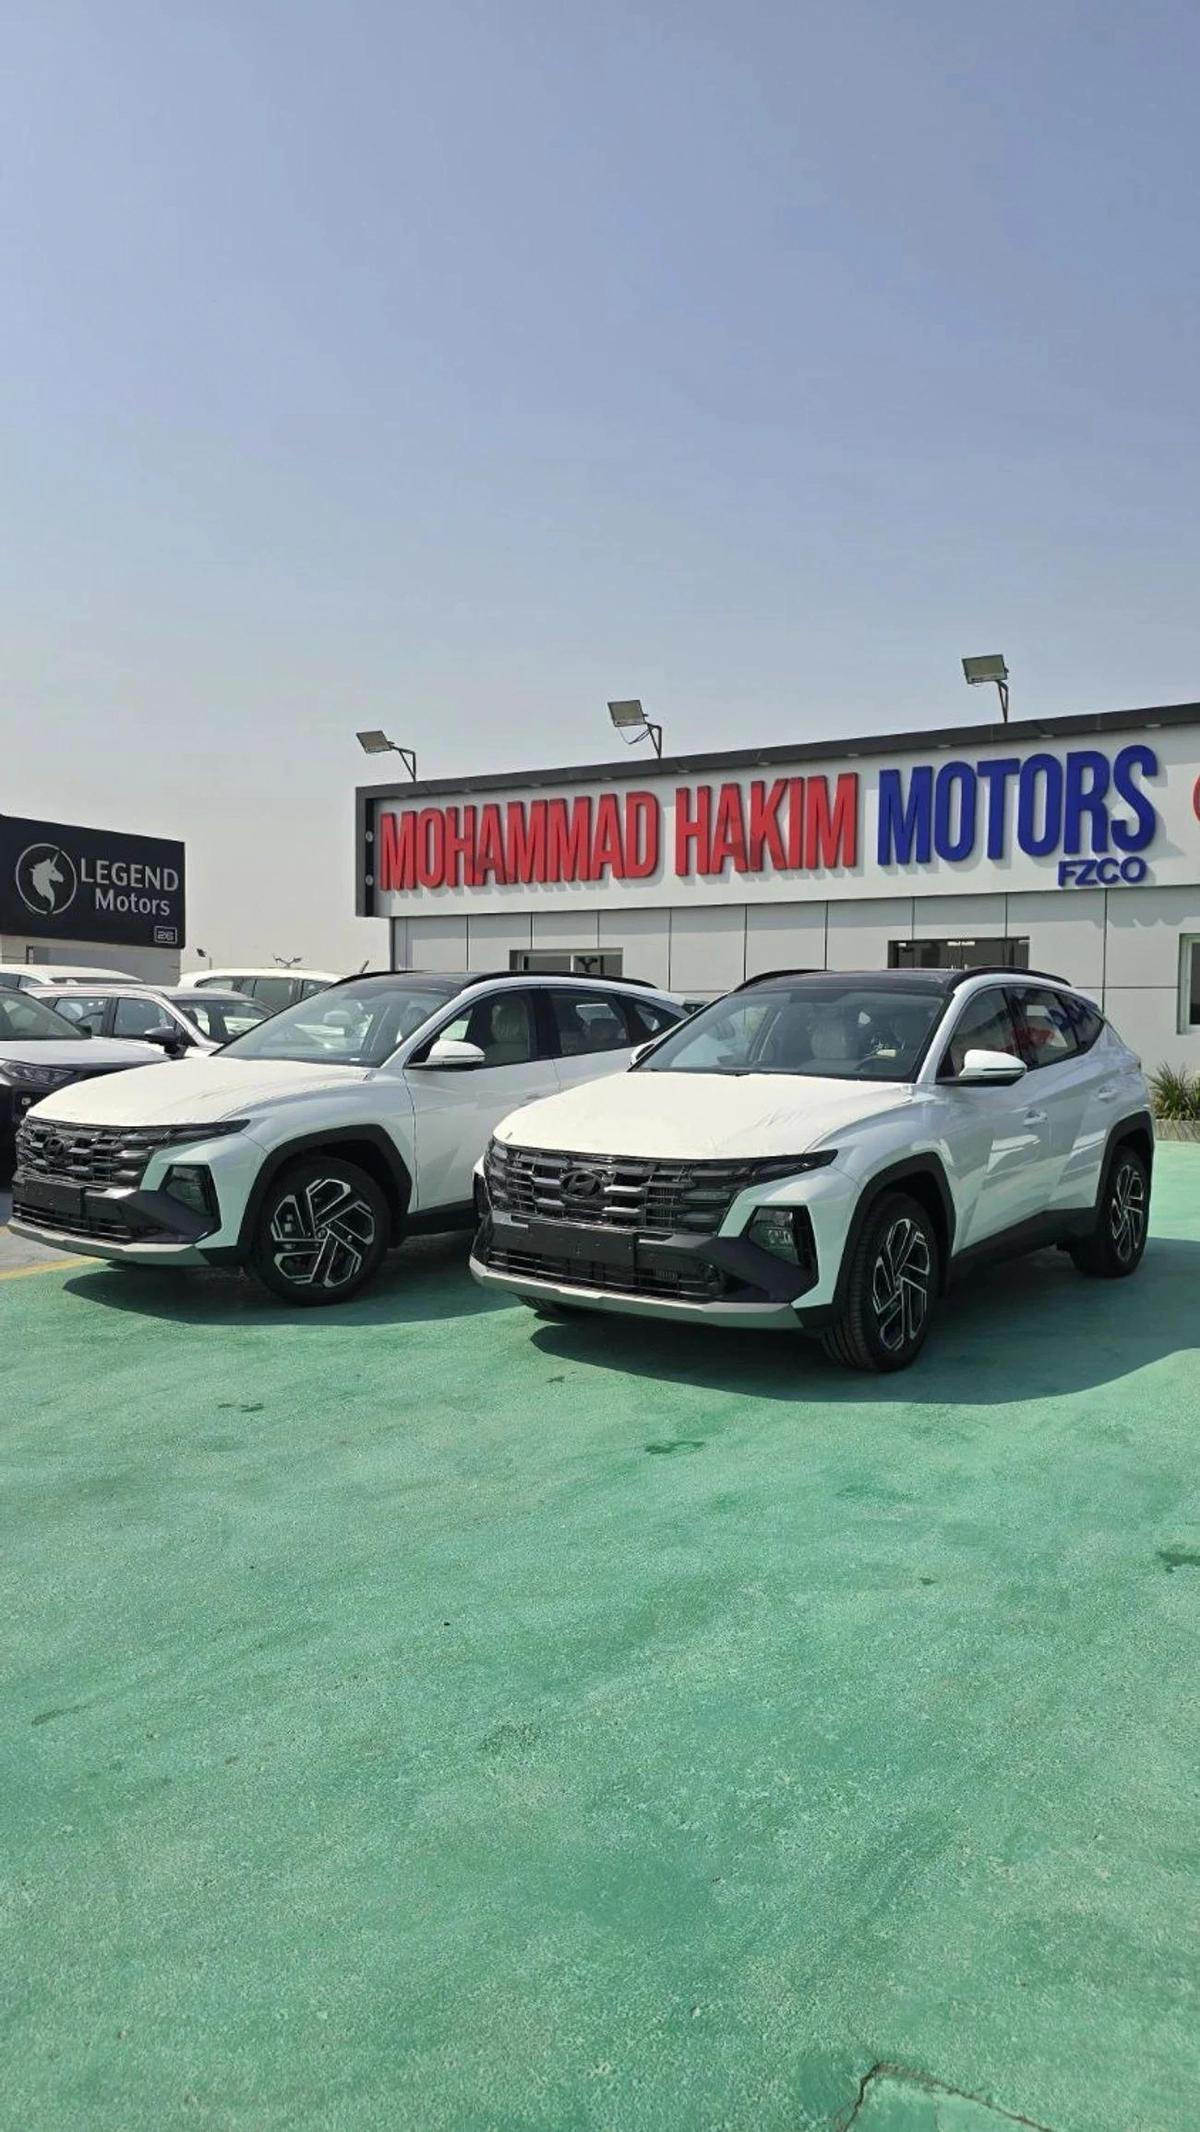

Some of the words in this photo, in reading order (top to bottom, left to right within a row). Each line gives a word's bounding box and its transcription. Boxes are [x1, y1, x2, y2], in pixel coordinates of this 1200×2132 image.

[380, 790, 659, 891] MOHAMMAD
[675, 772, 859, 877] HAKIM
[878, 745, 1158, 866] MOTORS
[80, 858, 179, 892] LEGEND
[1058, 856, 1147, 888] FZCO
[95, 887, 170, 916] Motors
